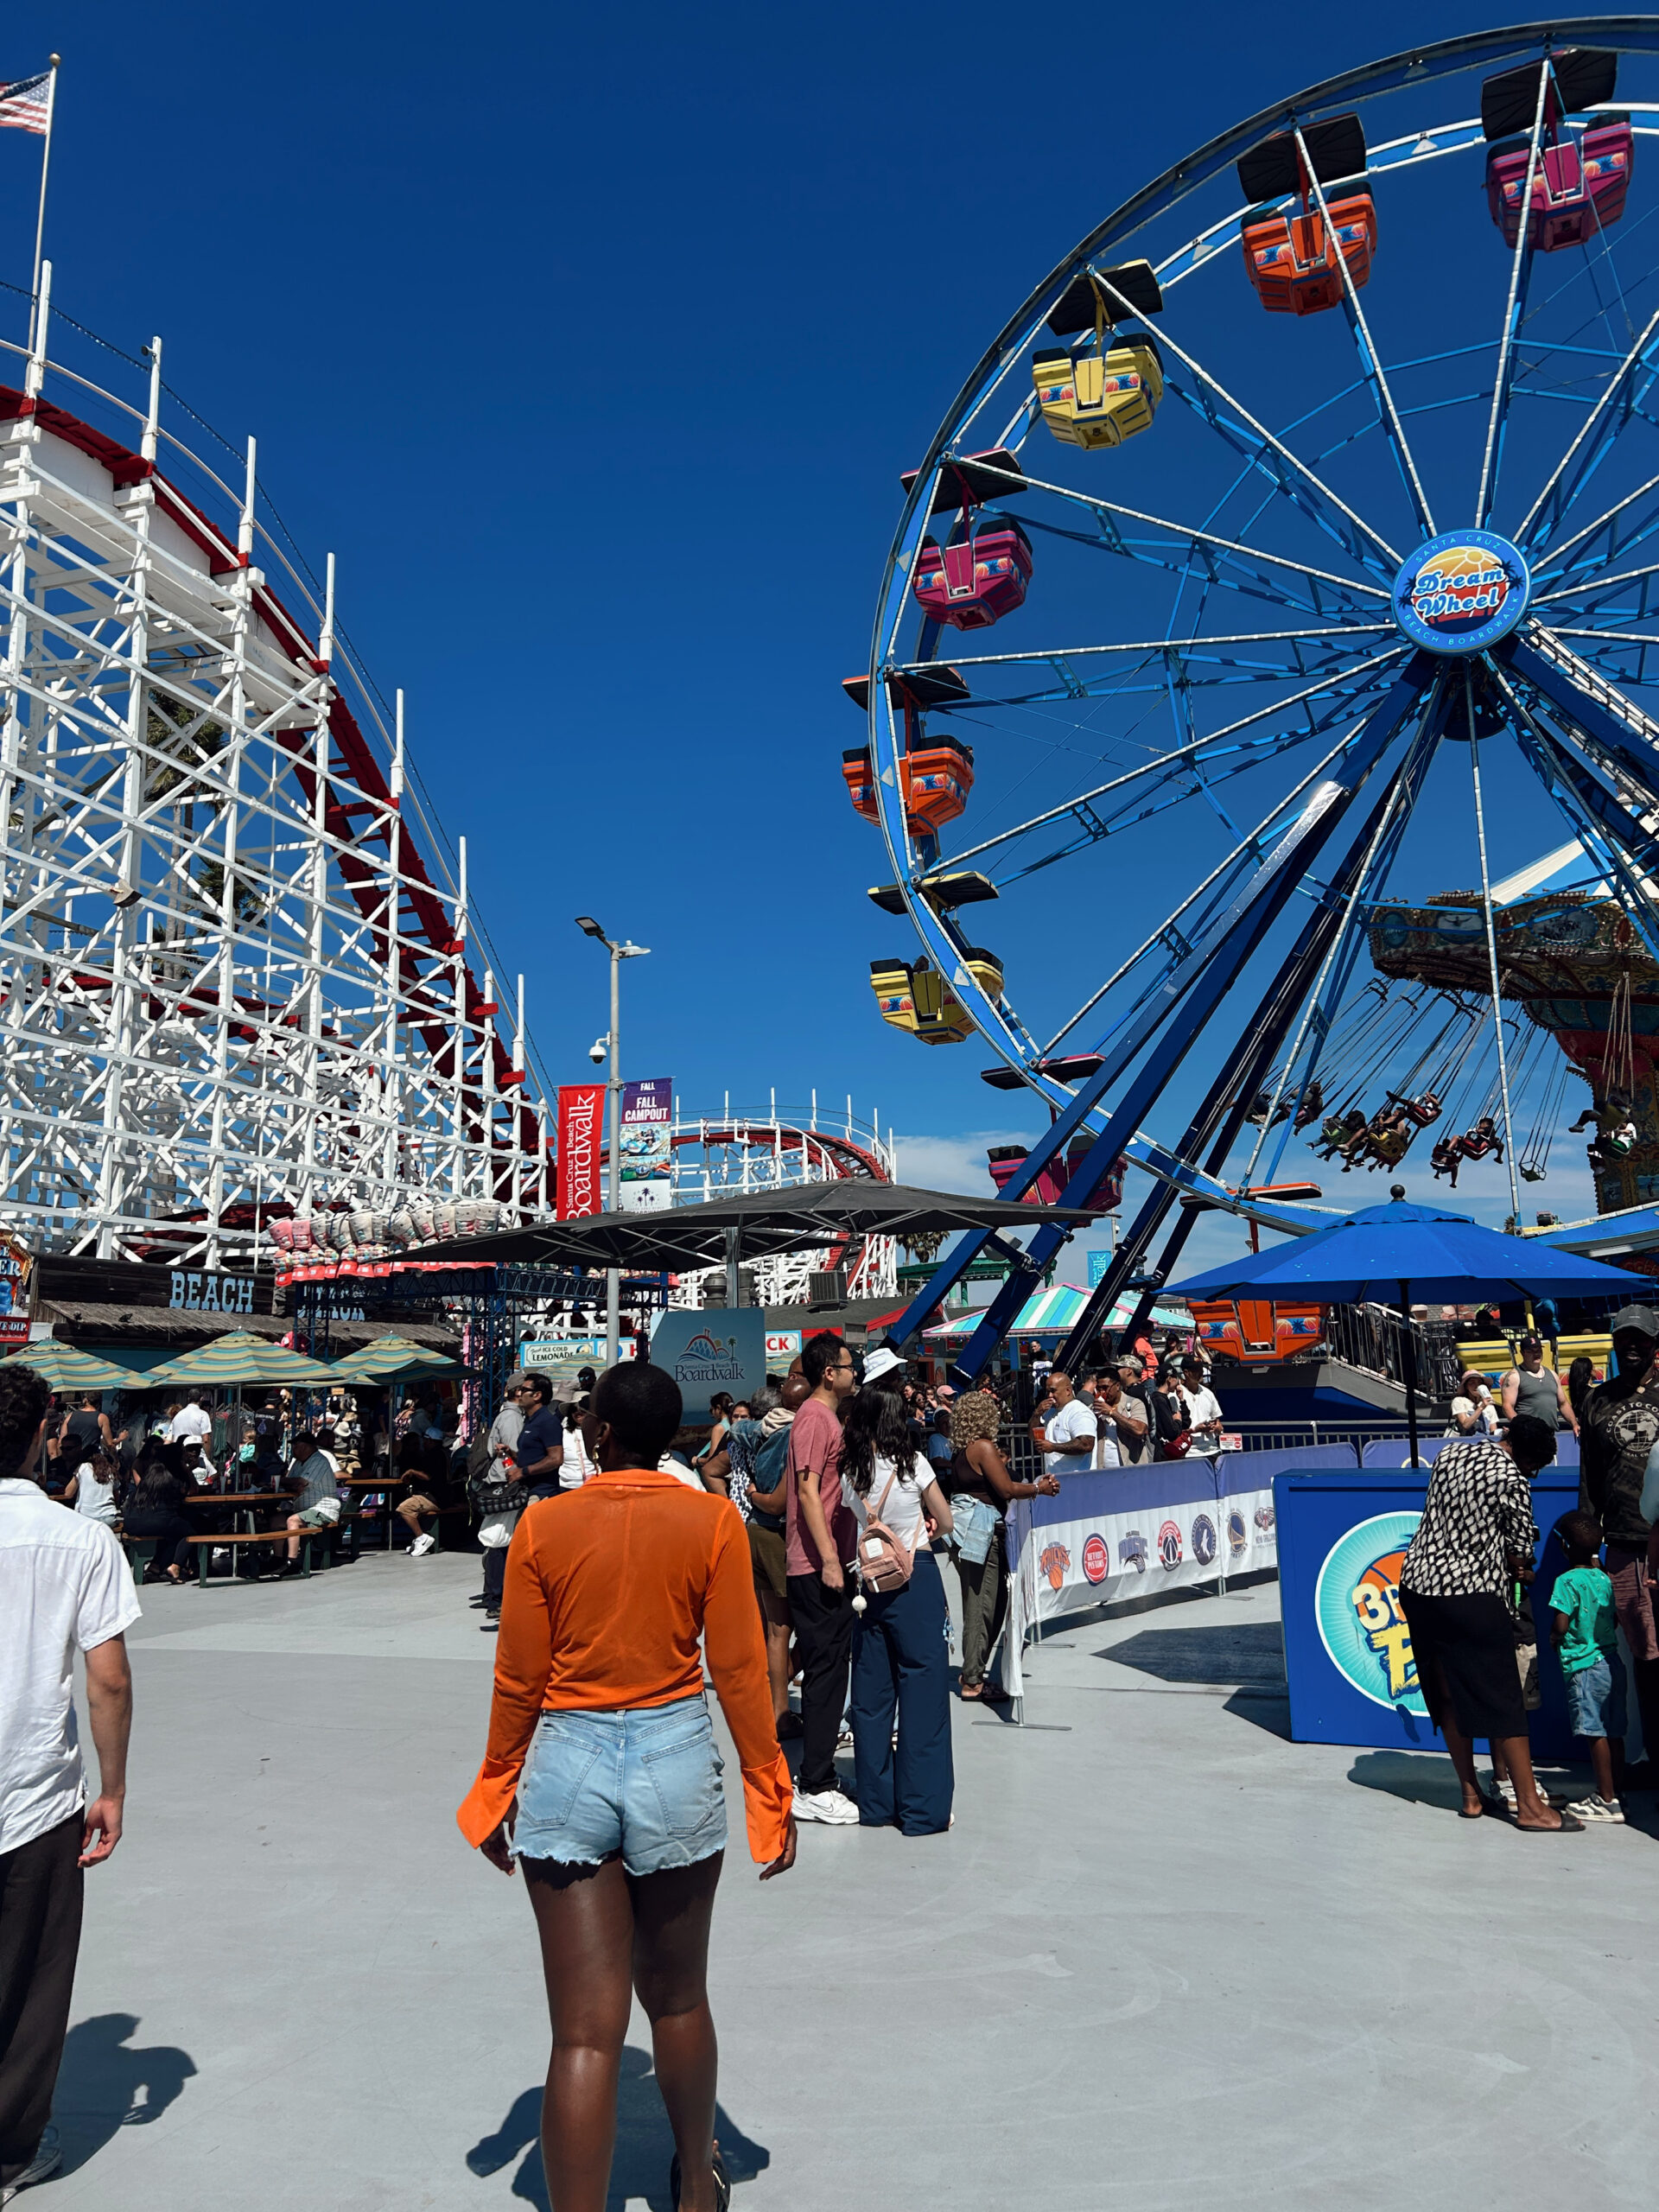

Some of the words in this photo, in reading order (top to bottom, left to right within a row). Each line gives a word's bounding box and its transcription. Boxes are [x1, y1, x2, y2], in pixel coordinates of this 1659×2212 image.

[1415, 537, 1457, 563] SANTA
[1465, 535, 1502, 550] CRUZ
[1414, 569, 1504, 596] Dream
[1415, 587, 1500, 618] Wheel
[1404, 613, 1440, 643] BEACH
[1447, 596, 1520, 645] BOARDWALK
[639, 1082, 656, 1091] FALL
[625, 1107, 669, 1122] CAMPOUT
[636, 1096, 658, 1109] FALL
[566, 1158, 575, 1183] Cruz
[566, 1185, 575, 1209] Santa
[168, 1271, 256, 1314] BEACH
[674, 1363, 746, 1382] Boardwalk
[1605, 1405, 1626, 1433] COAST
[1087, 1558, 1105, 1570] PISTONS
[1351, 1582, 1391, 1630] 3
